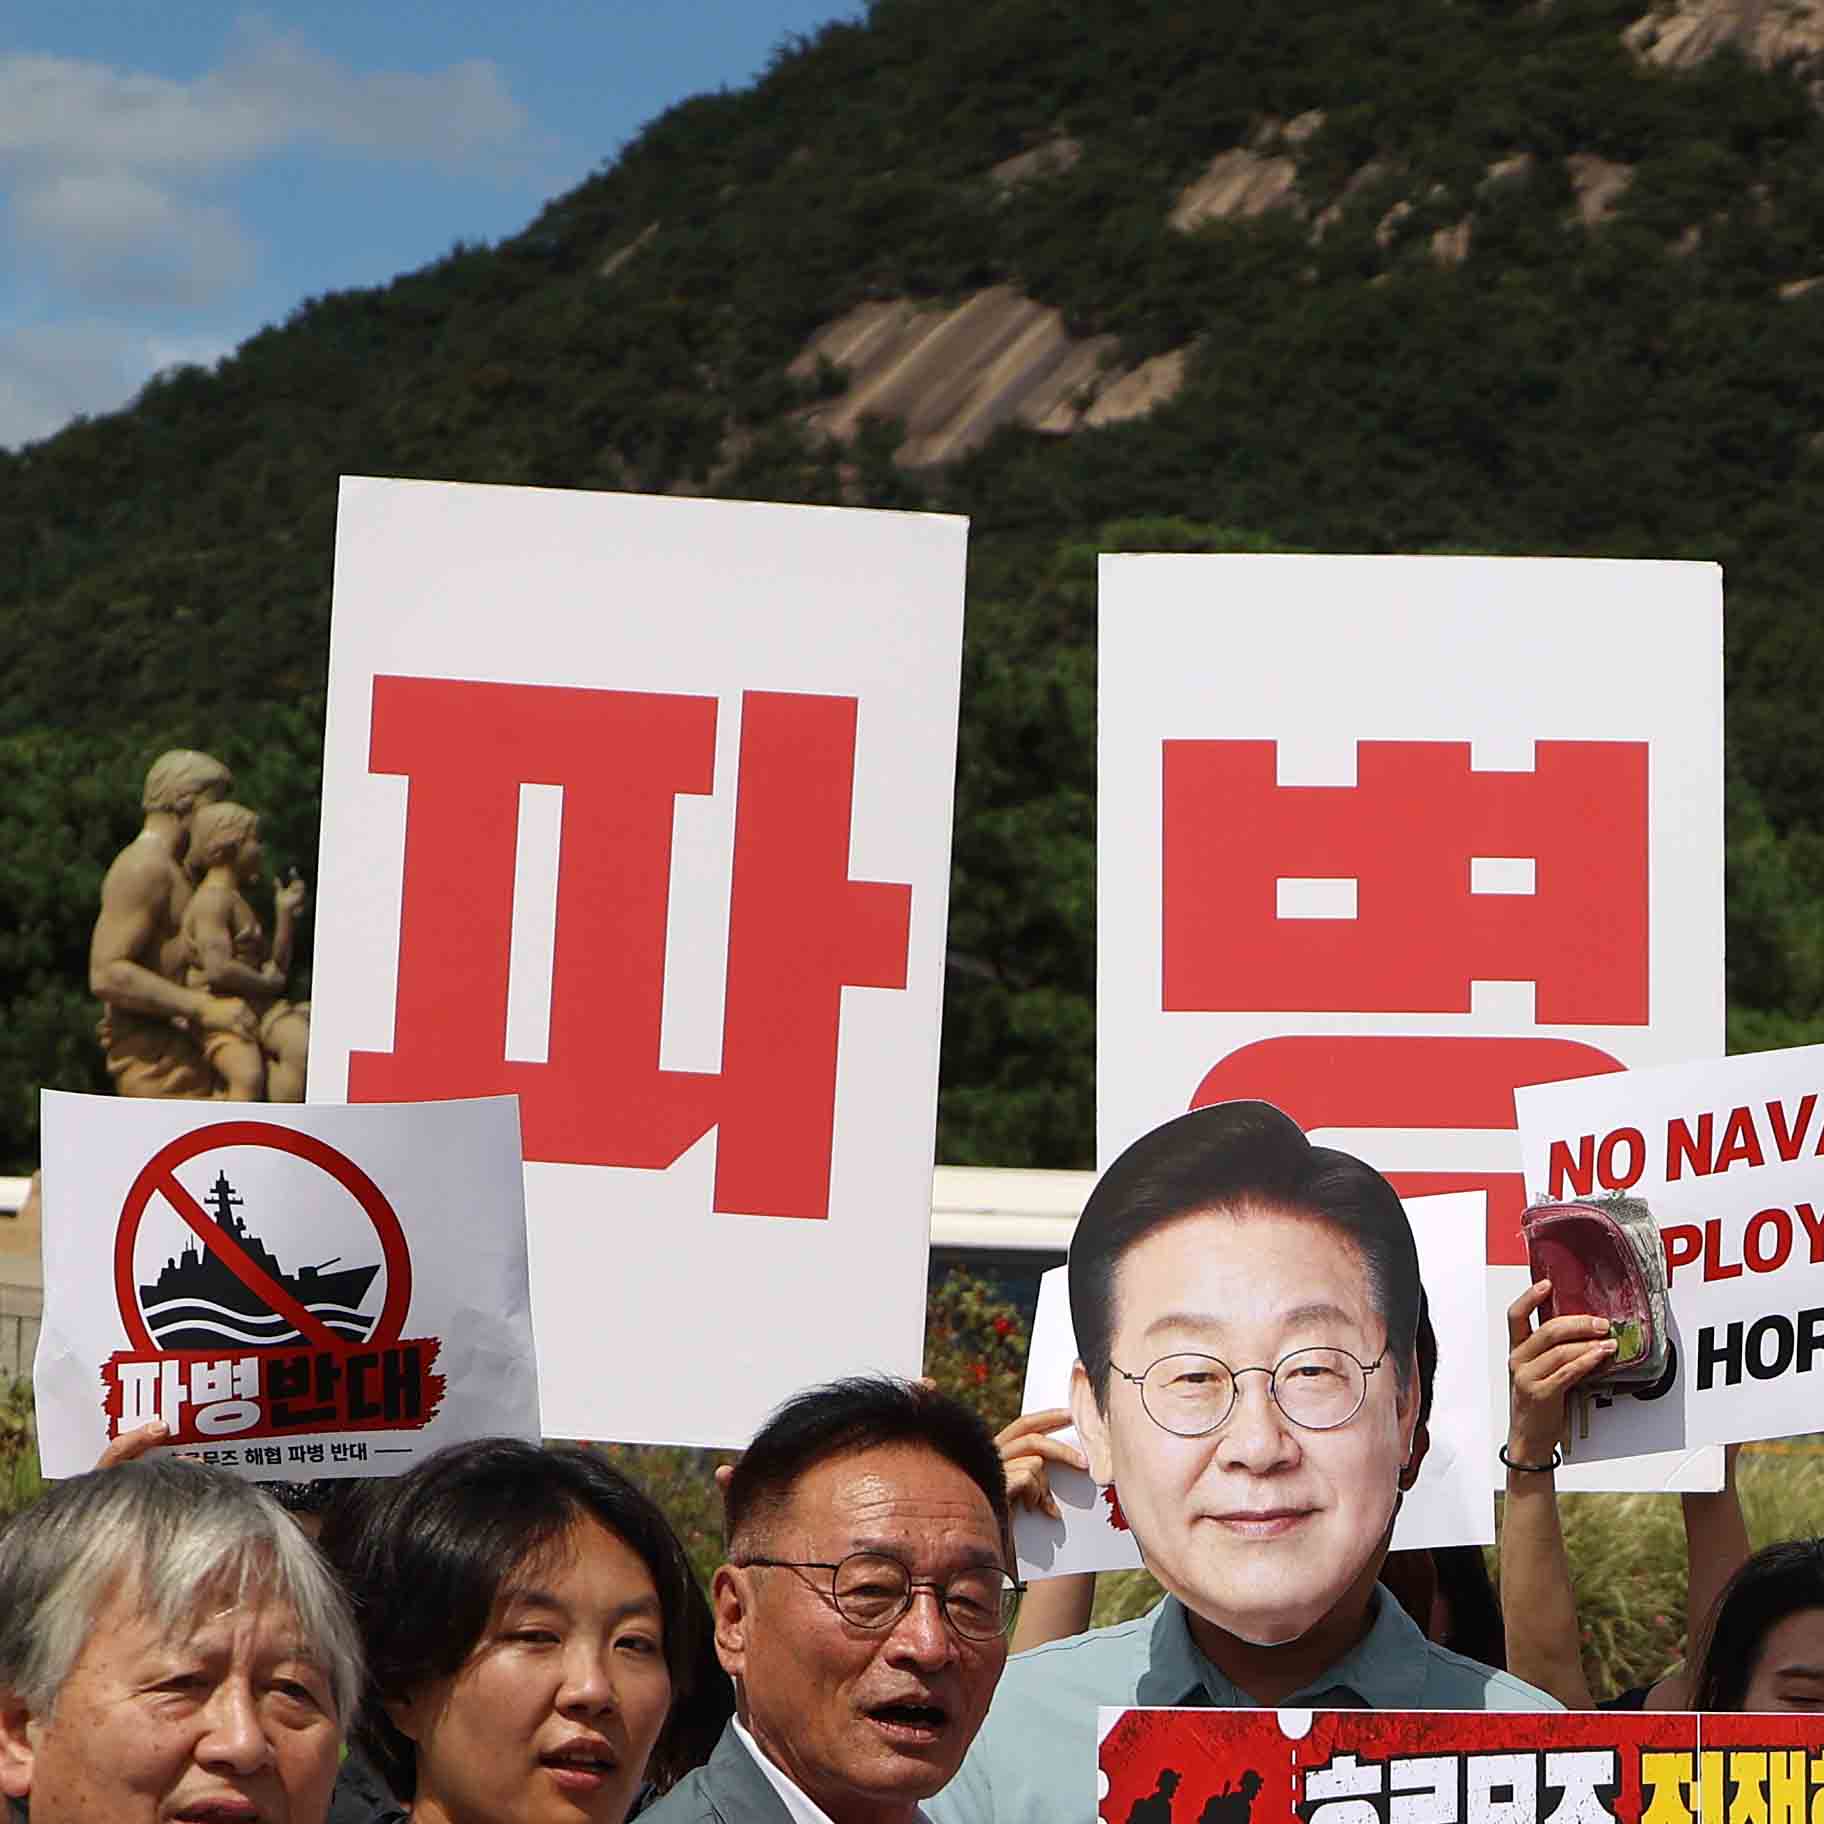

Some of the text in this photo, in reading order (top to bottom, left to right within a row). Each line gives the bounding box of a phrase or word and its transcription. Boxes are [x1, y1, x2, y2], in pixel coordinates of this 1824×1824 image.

[348, 673, 912, 1220] 파
[1162, 739, 1650, 1265] 병
[1548, 1127, 1646, 1200] NO
[116, 1347, 421, 1436] 파병반대
[245, 1446, 282, 1466] 해협
[287, 1443, 325, 1464] 파병
[331, 1442, 368, 1462] 반대
